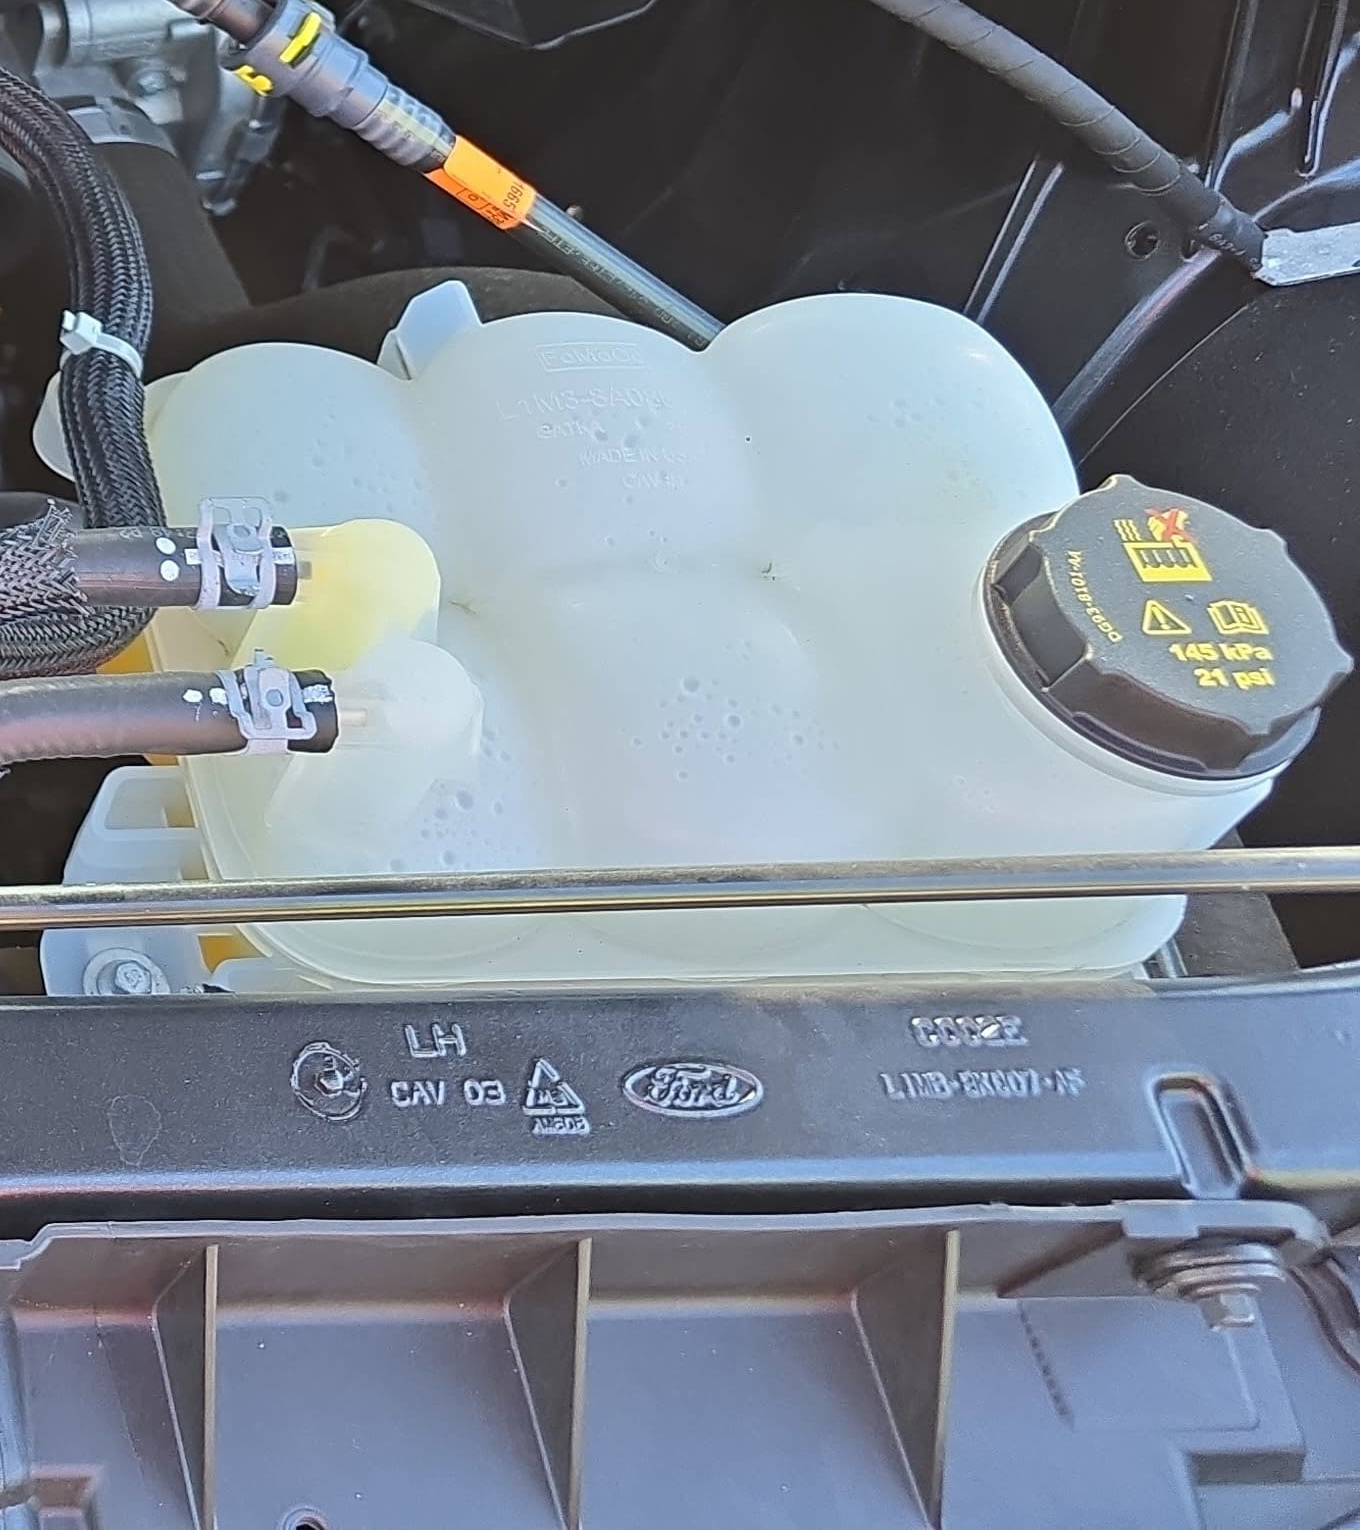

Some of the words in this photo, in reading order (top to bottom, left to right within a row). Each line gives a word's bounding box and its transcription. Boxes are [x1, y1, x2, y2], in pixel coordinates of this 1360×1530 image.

[1168, 642, 1220, 662] 145
[1221, 642, 1275, 662] kPa
[1193, 667, 1229, 687] 21
[1232, 666, 1276, 690] psi
[404, 1022, 467, 1059] LH
[390, 1080, 447, 1108] CAV
[640, 1064, 750, 1113] Ford
